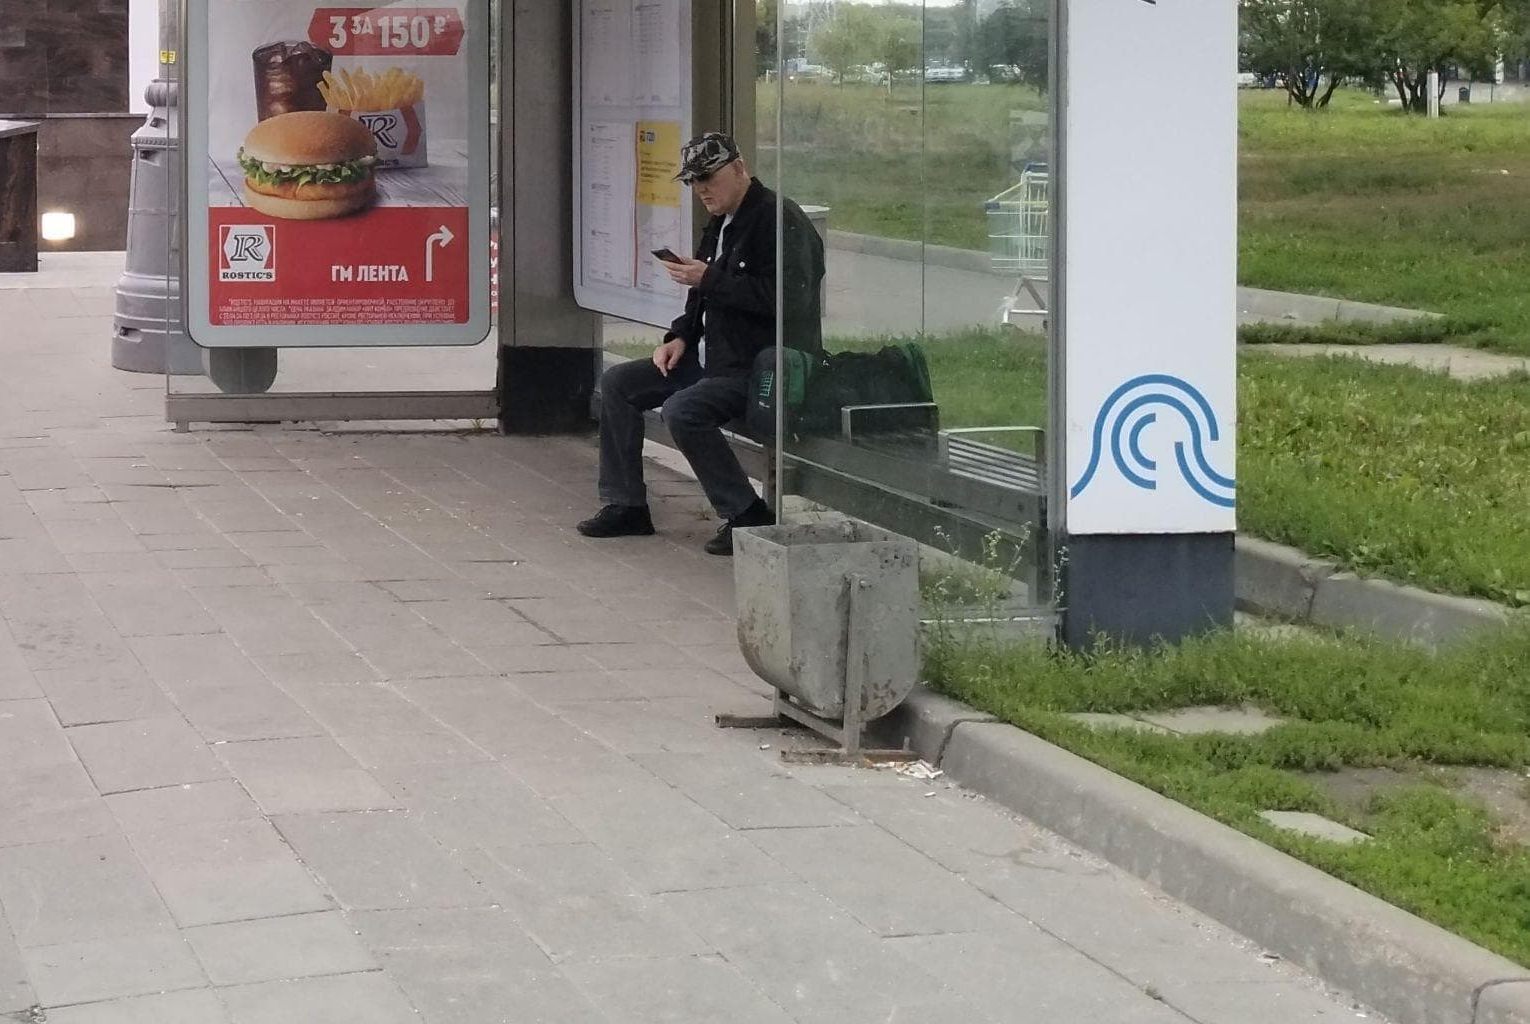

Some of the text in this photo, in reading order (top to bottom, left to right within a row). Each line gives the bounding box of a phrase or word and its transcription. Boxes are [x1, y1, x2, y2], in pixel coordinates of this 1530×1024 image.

[328, 16, 347, 48] 3
[377, 16, 430, 48] 150
[222, 271, 273, 280] ROSTIC'S
[331, 265, 409, 282] ГМ ЛЕНТА
